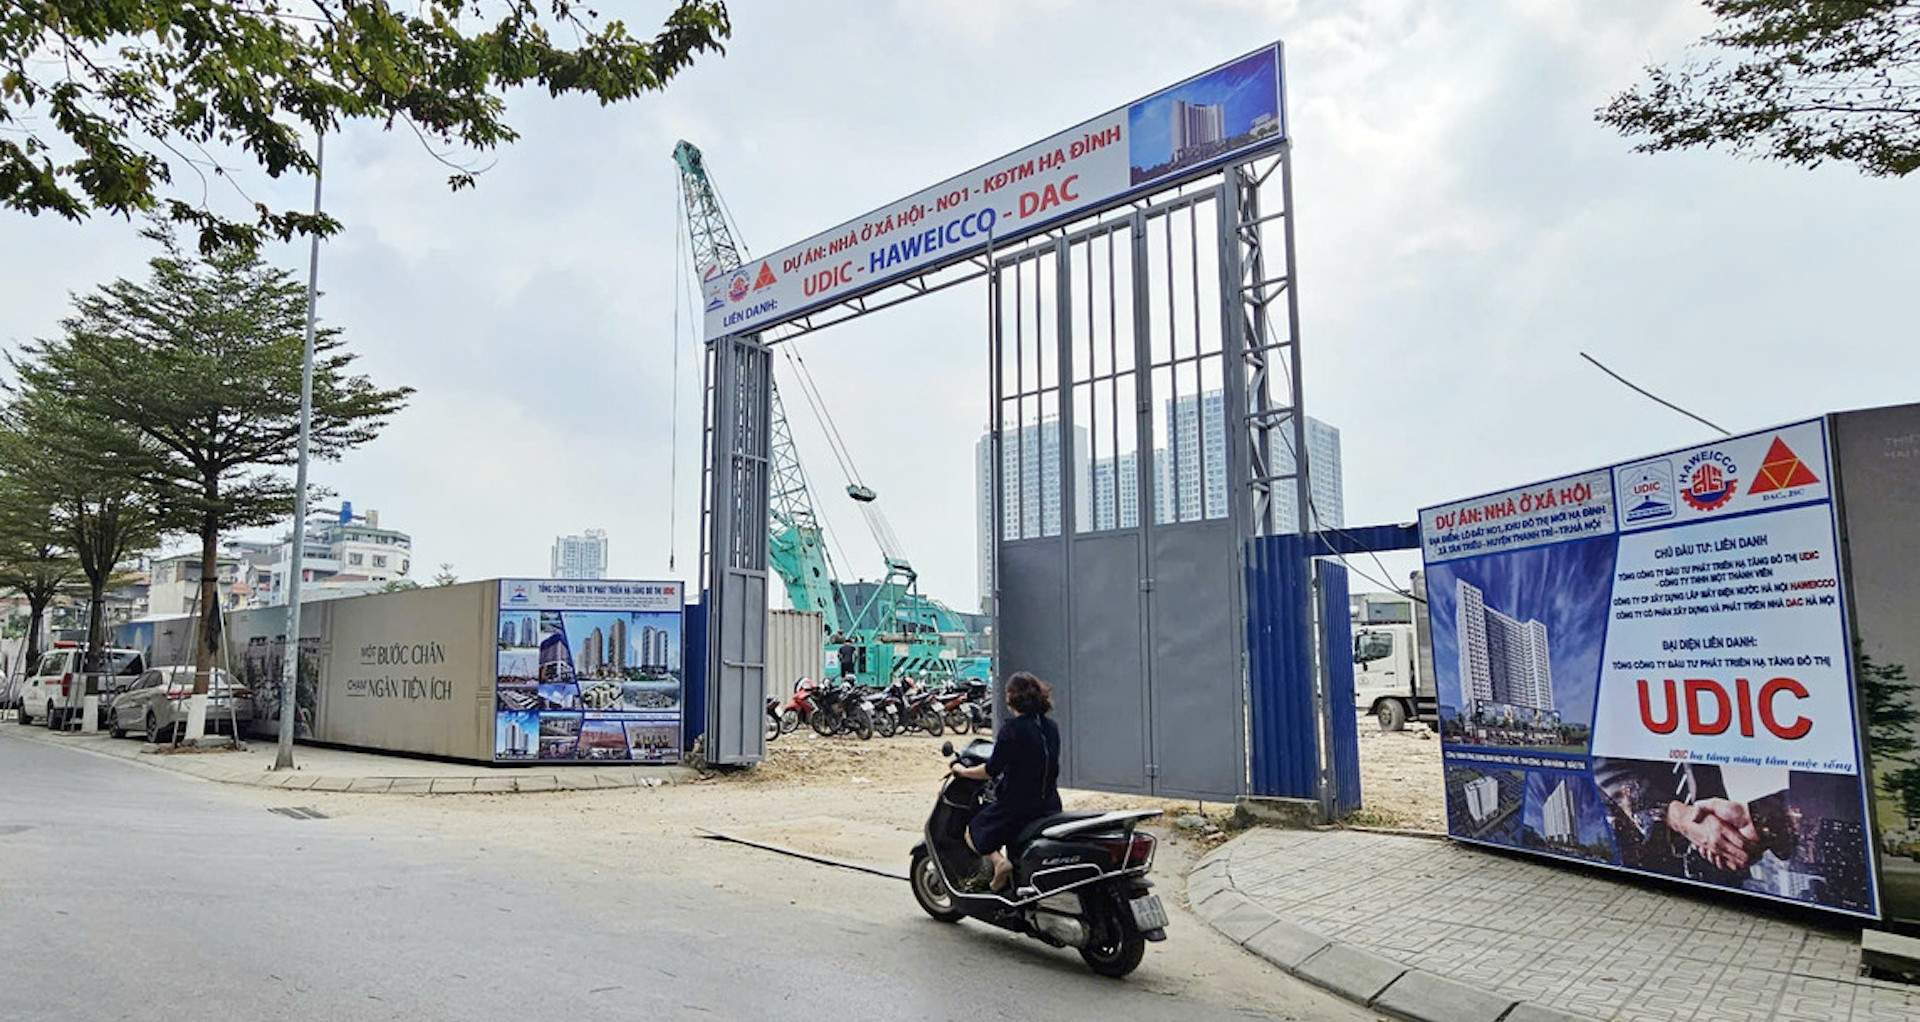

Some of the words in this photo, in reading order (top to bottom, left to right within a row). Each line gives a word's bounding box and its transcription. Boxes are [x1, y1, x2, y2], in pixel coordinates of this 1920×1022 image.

[783, 254, 802, 273] DỰ
[804, 246, 827, 263] ÁN:
[829, 232, 859, 255] NHÀ
[861, 224, 874, 241] Ở
[875, 215, 895, 235] XÃ
[897, 204, 924, 228] HỘI
[983, 160, 1034, 194] KĐTM
[1038, 148, 1066, 170] HẠ
[1070, 125, 1121, 160] ĐÌNH
[803, 261, 854, 297] UDIC
[870, 207, 996, 274] HAWEICCO
[1018, 175, 1079, 219] DAC
[723, 309, 745, 328] LIÊN
[746, 298, 778, 320] DANH:
[1679, 451, 1737, 484] HAWEICCO
[1633, 480, 1661, 494] UDIC
[1458, 506, 1482, 526] ÁN:
[1485, 497, 1516, 521] NHÀ
[1519, 493, 1533, 513] Ở
[1535, 488, 1557, 510] XÃ
[1560, 482, 1592, 506] HỘI
[1654, 545, 1674, 559] CHỦ
[1674, 543, 1694, 557] ĐẦU
[1715, 536, 1736, 551] LIÊN
[1738, 534, 1768, 549] DANH
[1656, 568, 1664, 577] TY
[1692, 562, 1711, 573] PHÁT
[1747, 556, 1769, 567] TẦNG
[1770, 553, 1783, 564] ĐÔ
[1799, 550, 1820, 561] UDIC
[1680, 577, 1689, 586] TY
[1761, 582, 1773, 593] HÀ
[1774, 582, 1788, 593] NỘI
[1791, 578, 1837, 591] HAWEICCO
[1722, 601, 1741, 613] PHÁT
[1767, 598, 1785, 608] NHÀ
[1785, 597, 1805, 608] DAC
[1805, 595, 1818, 606] HÀ
[1819, 594, 1835, 606] NỘI
[377, 642, 409, 665] BƯỚC
[411, 641, 445, 664] CHÂN
[1662, 639, 1678, 652] ĐẠI
[1679, 637, 1701, 652] DIỆN
[1703, 635, 1724, 649] LIÊN
[1726, 636, 1758, 648] DANH:
[1633, 659, 1655, 669] CÔNG
[1656, 660, 1667, 668] TY
[1700, 657, 1722, 668] PHÁT
[1752, 657, 1766, 668] HẠ
[1767, 655, 1795, 667] TẦNG
[1797, 654, 1812, 667] ĐÔ
[1813, 656, 1831, 667] THỊ
[401, 676, 428, 702] TIỆN
[430, 677, 452, 700] ÍCH
[1636, 677, 1814, 741] UDIC
